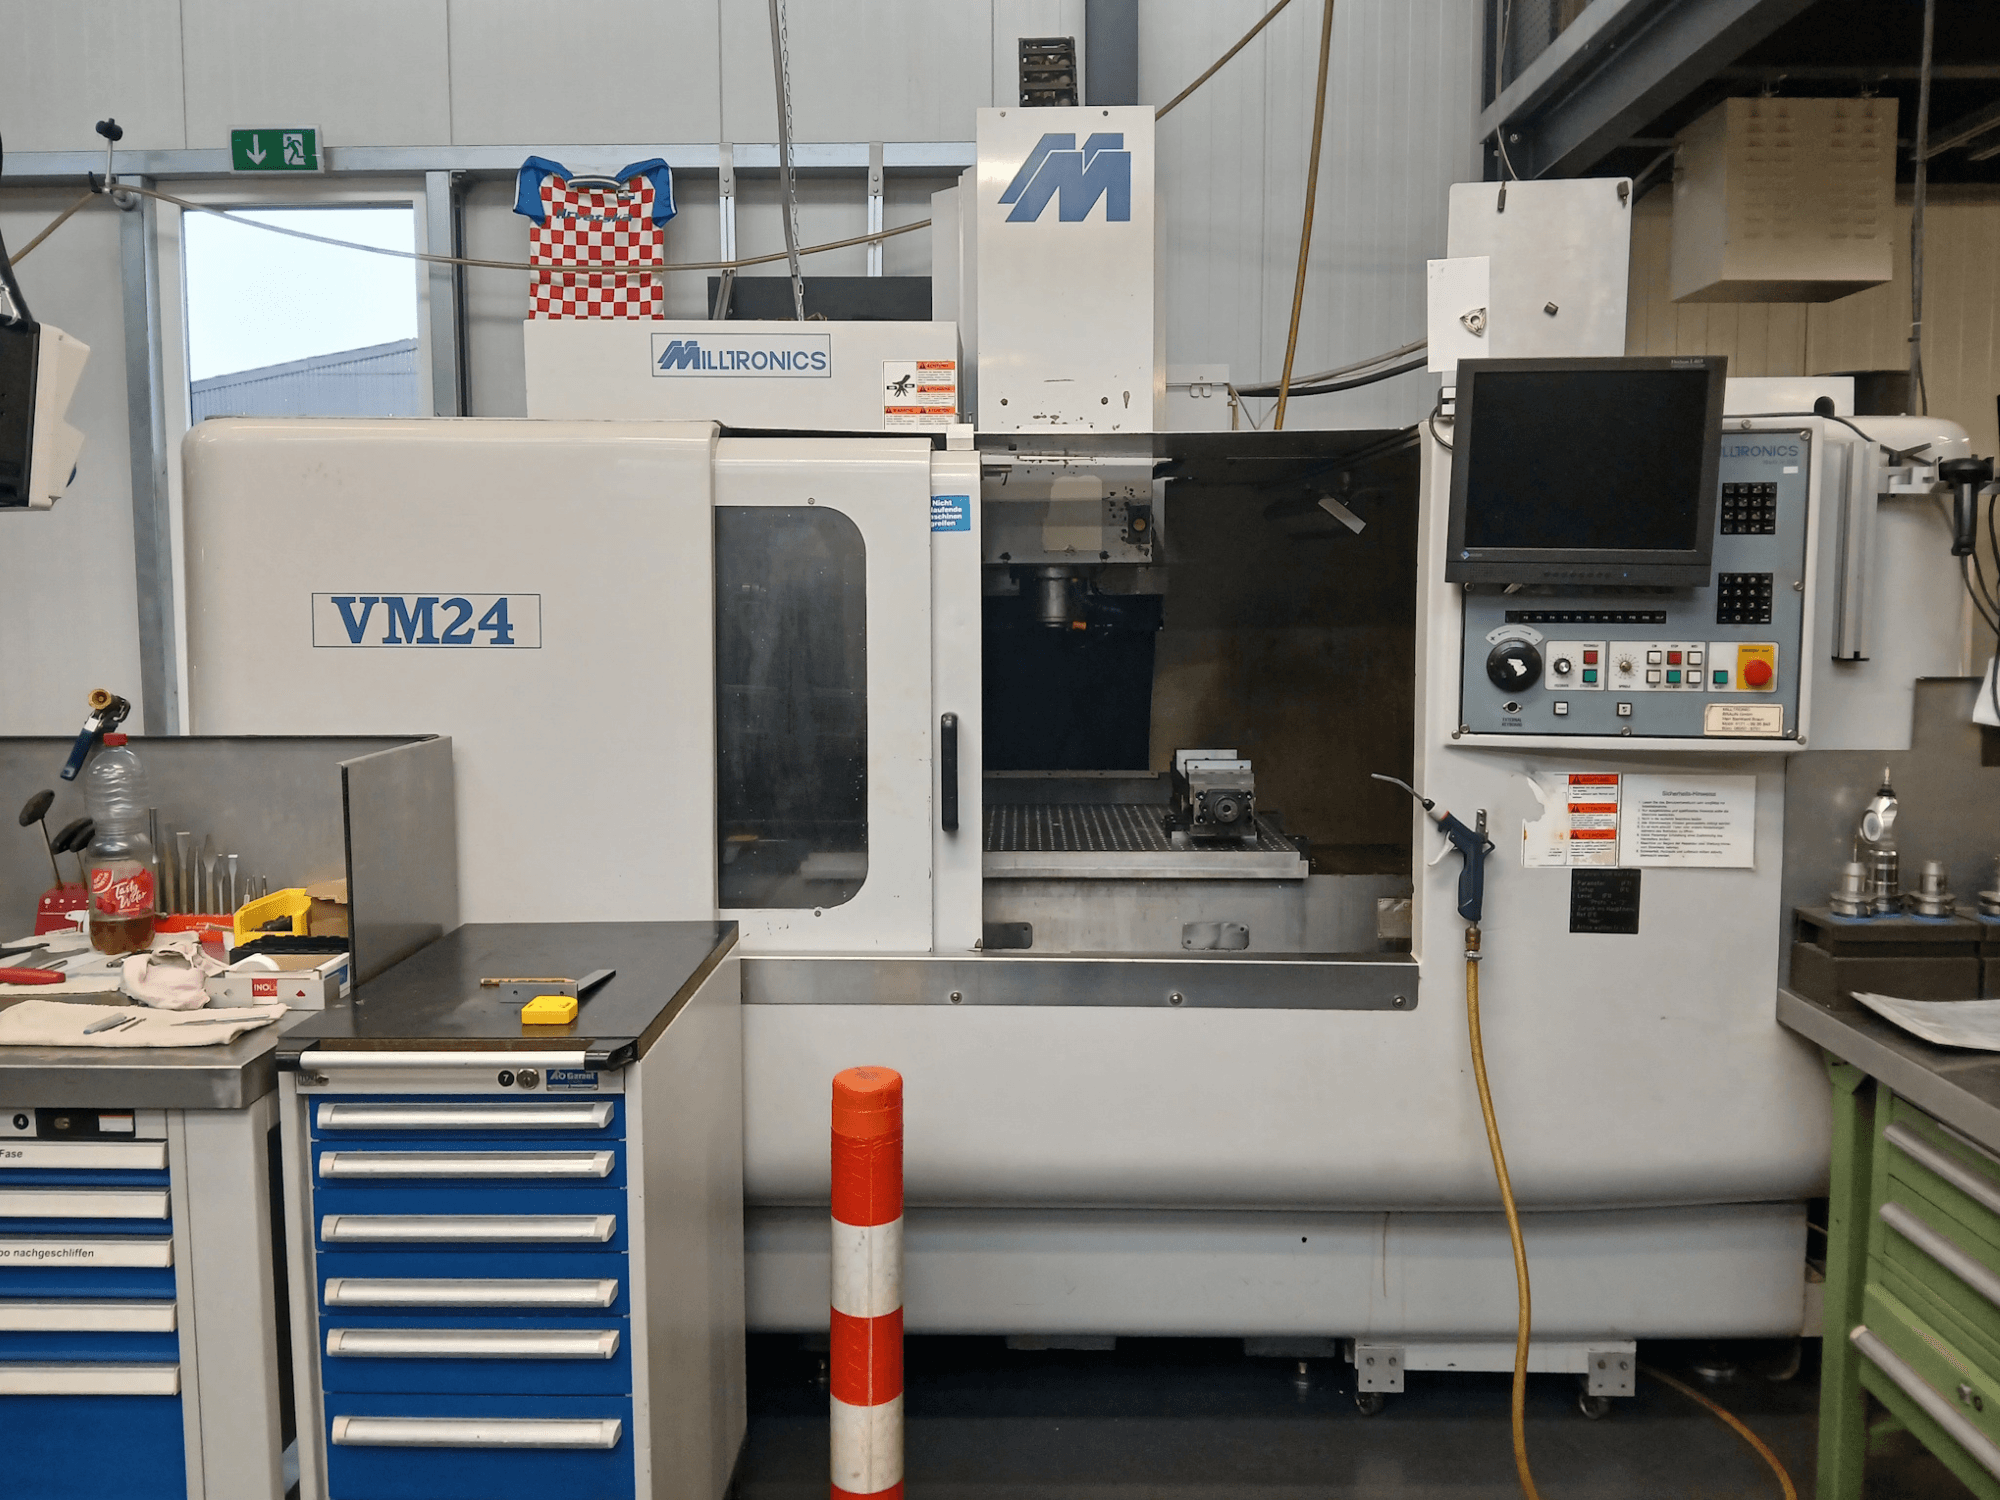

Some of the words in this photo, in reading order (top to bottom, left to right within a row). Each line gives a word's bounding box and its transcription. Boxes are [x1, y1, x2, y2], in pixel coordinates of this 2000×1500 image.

[657, 340, 827, 371] MILLTRONICS
[1721, 445, 1799, 458] LLTRONICS
[331, 597, 514, 645] VM24
[567, 1071, 595, 1081] Garant
[0, 1149, 23, 1159] Fase
[13, 1248, 95, 1260] nachgeschliffen
